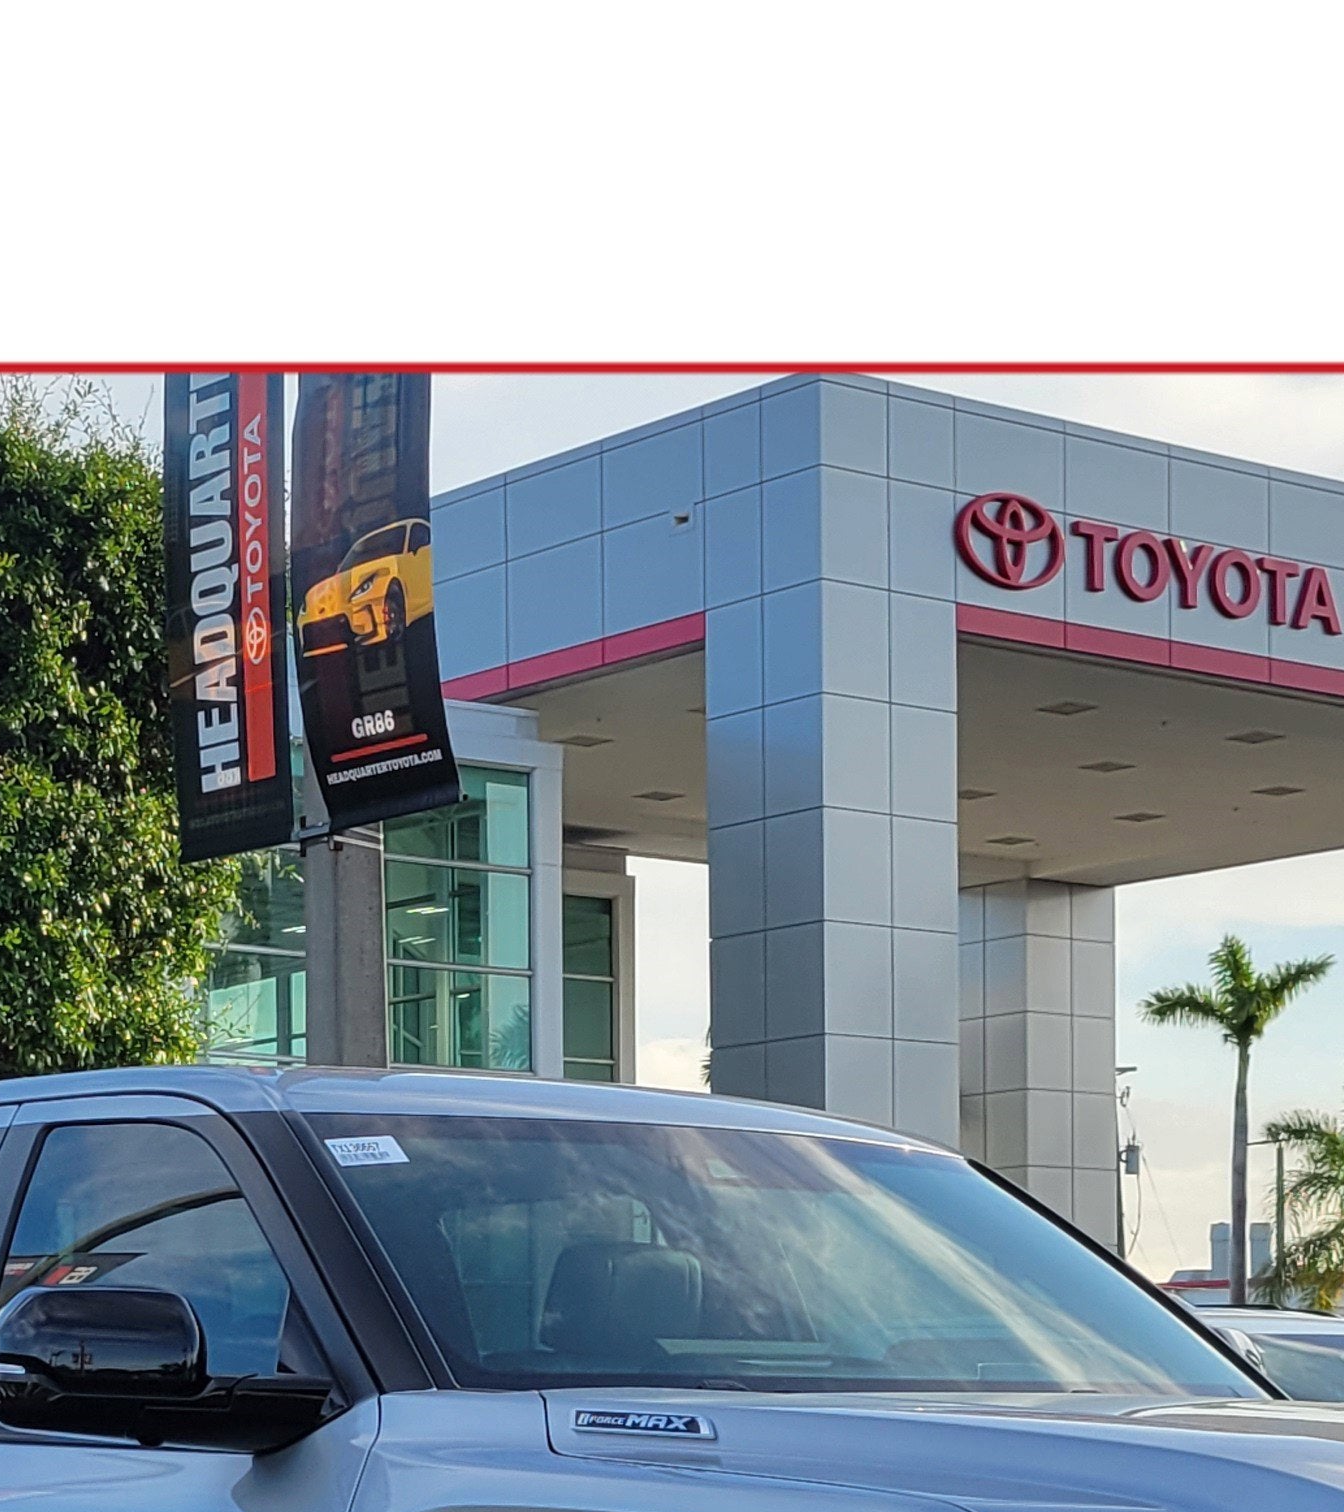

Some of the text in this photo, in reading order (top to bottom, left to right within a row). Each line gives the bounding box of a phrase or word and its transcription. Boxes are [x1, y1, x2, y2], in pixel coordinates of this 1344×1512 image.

[243, 413, 263, 590] TOYOTA
[1072, 520, 1343, 636] TOYOTA
[351, 710, 395, 739] GR86
[326, 749, 443, 785] HEADQUARTERTOYOTA.COM
[625, 1414, 693, 1431] MAX
